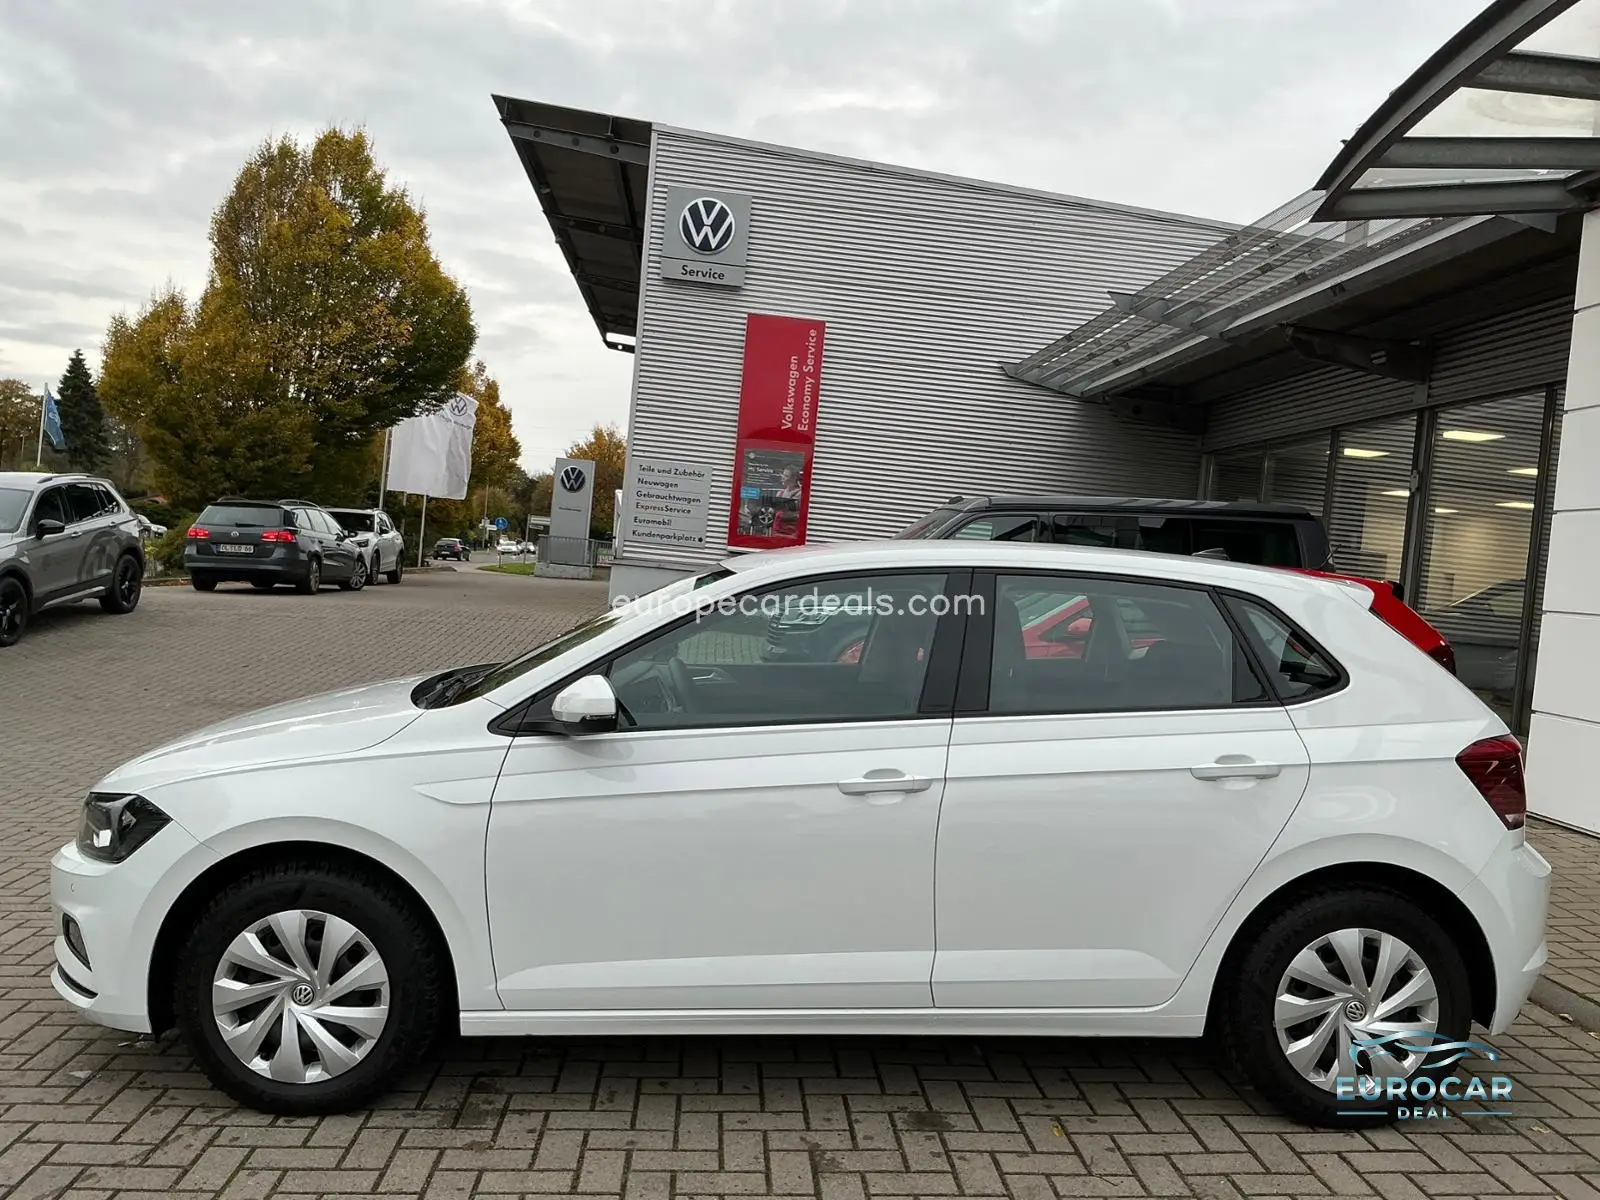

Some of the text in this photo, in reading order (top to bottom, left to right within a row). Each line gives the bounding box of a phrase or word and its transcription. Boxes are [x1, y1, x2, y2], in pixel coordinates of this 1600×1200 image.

[680, 197, 735, 255] VW
[682, 265, 725, 280] Service
[798, 329, 818, 431] Economy Service
[781, 356, 799, 429] Volkswagen
[638, 465, 705, 478] Teile und Zubehör
[637, 478, 679, 488] Neuwagen
[636, 491, 701, 504] Gebrauchtwagen
[633, 516, 672, 526] Euromobil
[632, 530, 697, 543] Kundenparkplatz
